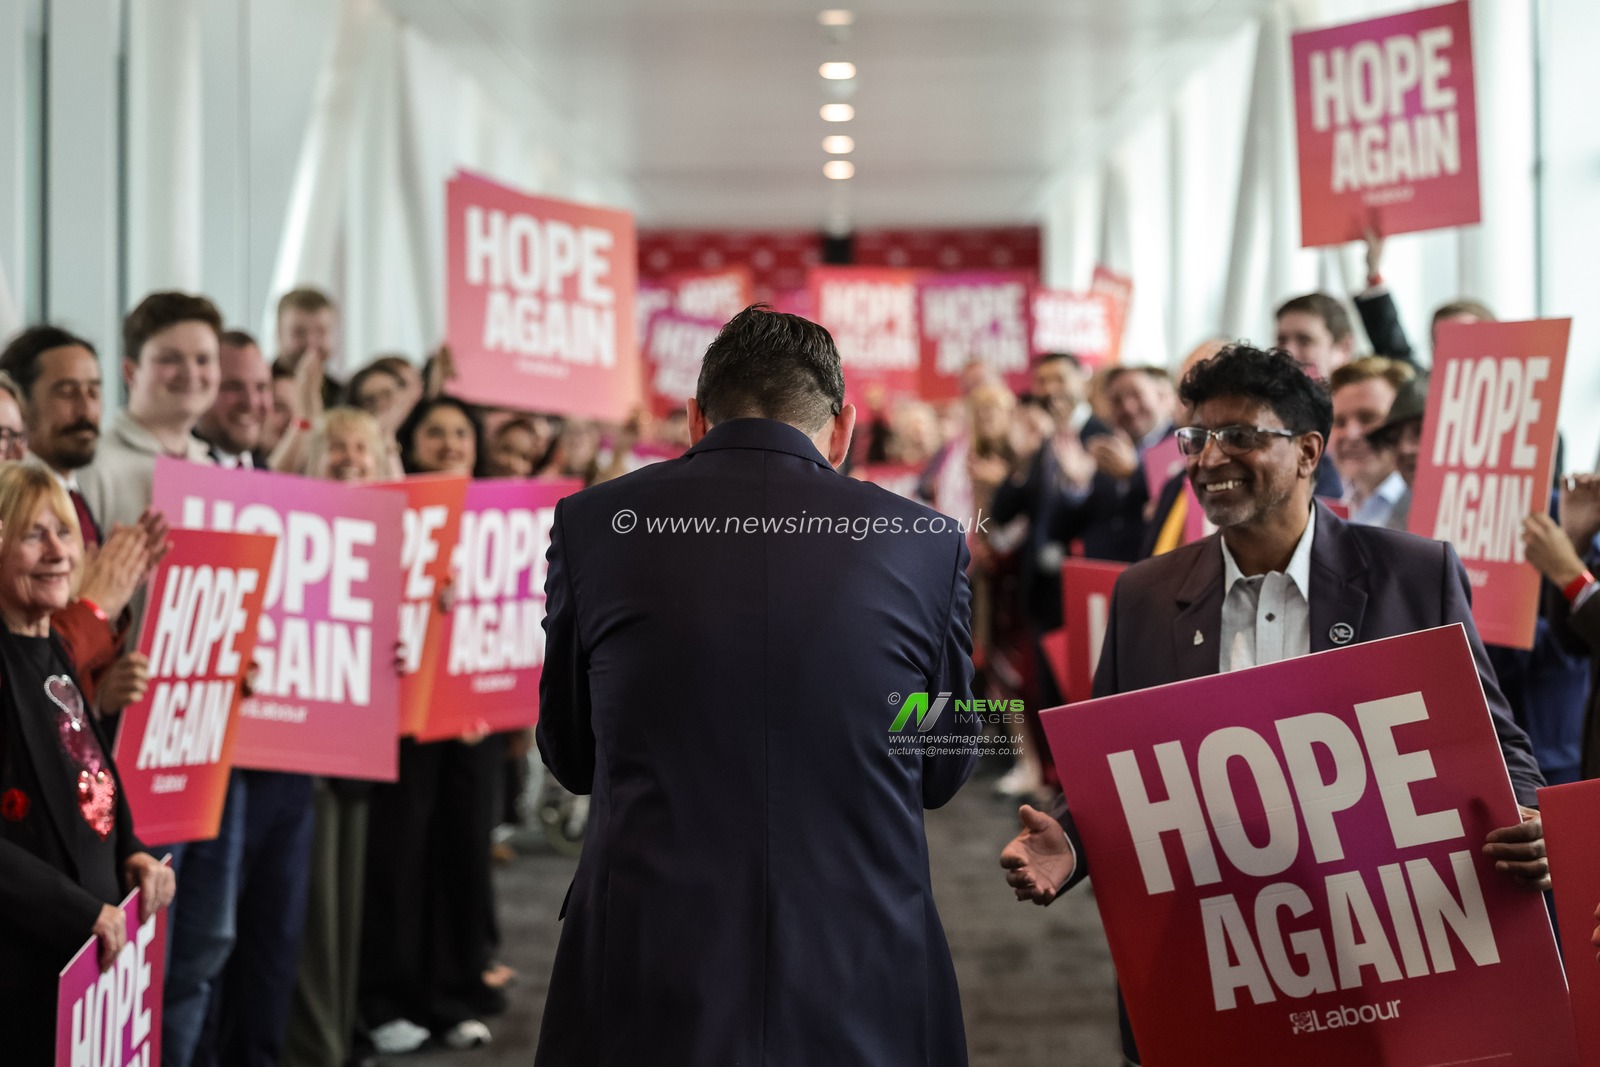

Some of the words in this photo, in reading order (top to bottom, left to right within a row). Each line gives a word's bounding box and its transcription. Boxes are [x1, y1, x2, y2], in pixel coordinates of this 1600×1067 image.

[1309, 26, 1456, 131] HOPE
[1331, 110, 1460, 192] AGAIN
[465, 205, 614, 305] HOPE
[484, 291, 615, 367] AGAIN
[923, 284, 1027, 341] HOPE
[1432, 356, 1551, 469] HOPE
[1432, 472, 1534, 564] AGAIN
[148, 565, 259, 678] HOPE
[251, 615, 372, 705] GAIN
[136, 680, 235, 770] AGAIN
[1107, 691, 1465, 895] HOPE
[1200, 850, 1501, 1012] AGAIN
[70, 912, 156, 1067] HOPE
[1311, 999, 1401, 1031] Labour
